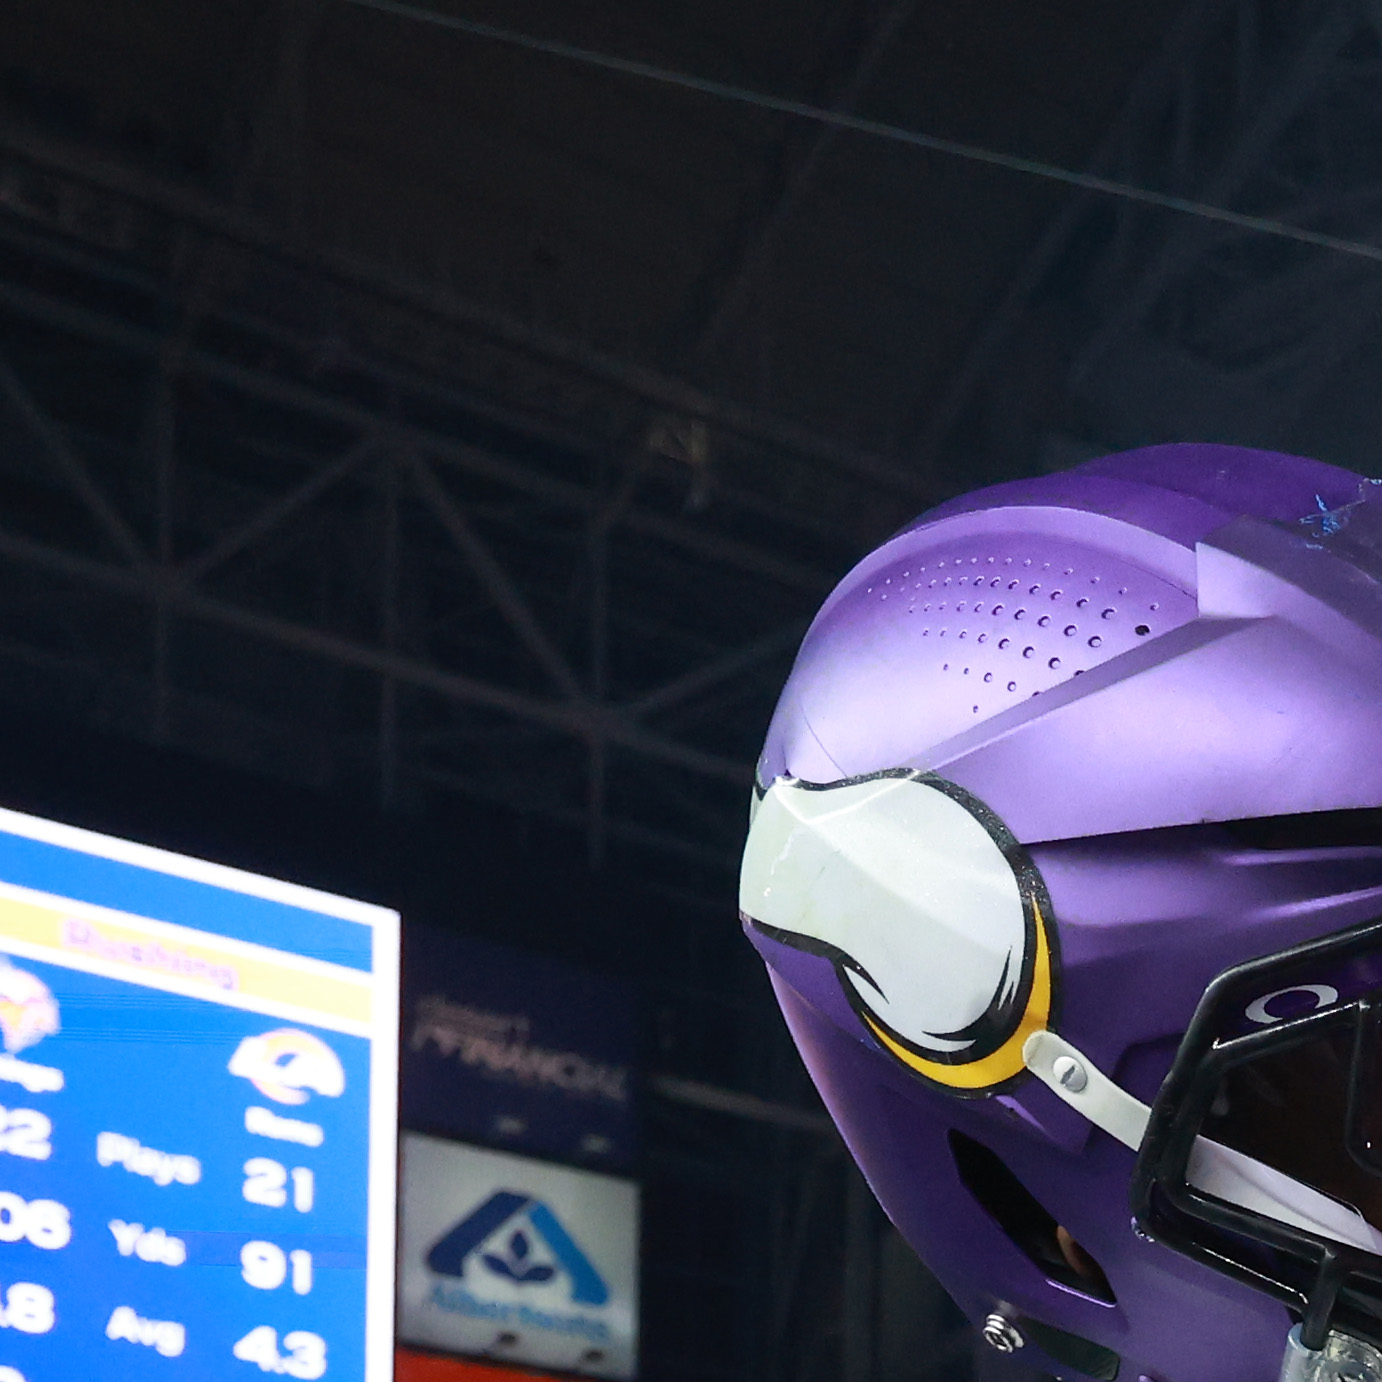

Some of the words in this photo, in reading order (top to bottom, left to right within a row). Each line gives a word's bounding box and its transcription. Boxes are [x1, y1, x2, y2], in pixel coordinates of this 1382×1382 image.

[97, 1131, 200, 1185] Plays
[242, 1157, 313, 1213] 21
[108, 1219, 186, 1266] Yds
[240, 1240, 312, 1295] 91
[106, 1306, 185, 1357] Avg
[233, 1325, 327, 1380] 4.3
